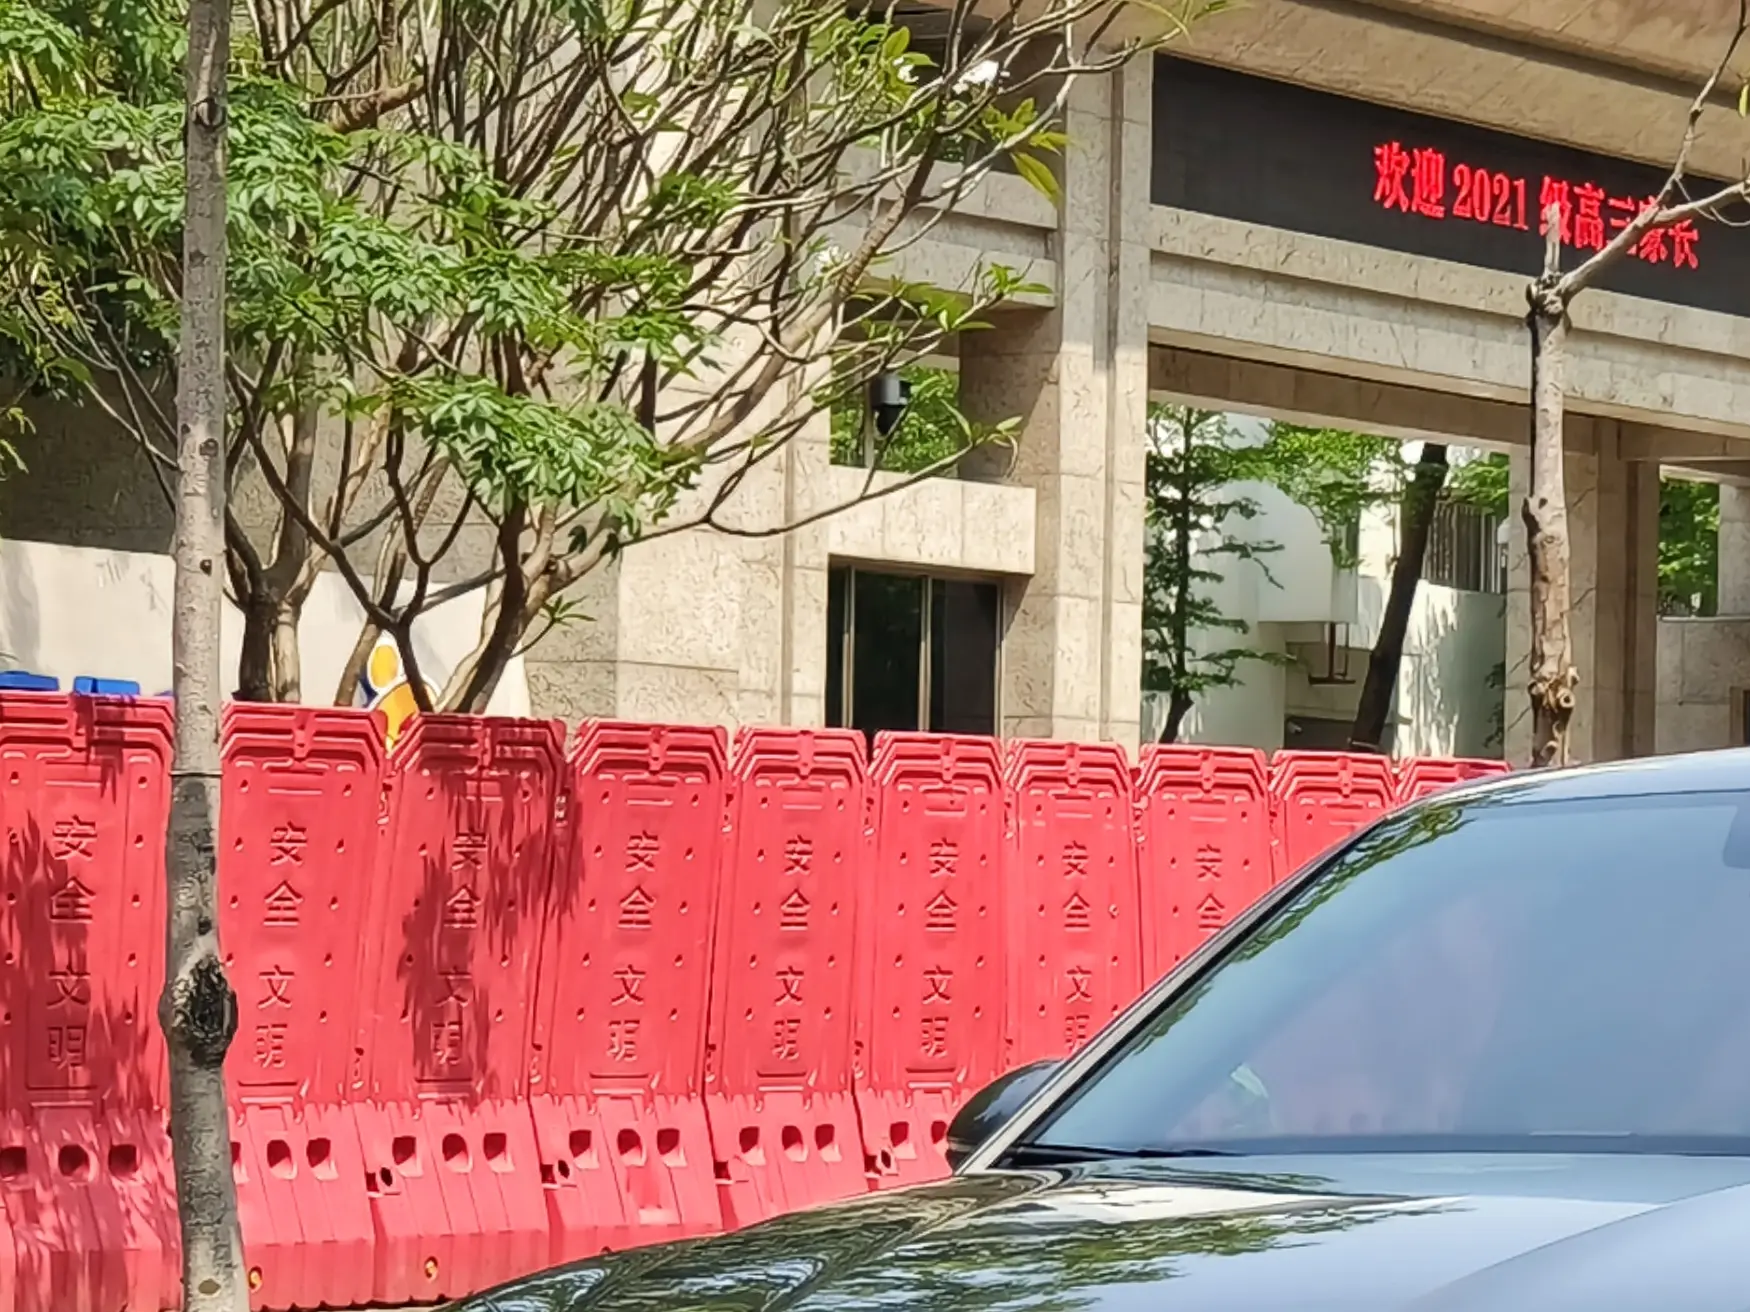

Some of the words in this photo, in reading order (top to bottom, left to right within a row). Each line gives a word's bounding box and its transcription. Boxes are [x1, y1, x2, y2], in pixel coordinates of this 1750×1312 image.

[1374, 142, 1446, 218] 欢迎
[1453, 163, 1530, 230] 2021
[47, 815, 98, 1069] 安全文明
[253, 821, 308, 1068] 安全文明
[431, 826, 488, 1064] 安全文明
[606, 830, 660, 1062] 安全文明
[772, 834, 814, 1060] 安全文明
[921, 837, 960, 1058] 安全文明
[1061, 840, 1093, 1052] 安全文明
[1194, 844, 1226, 930] 安全
